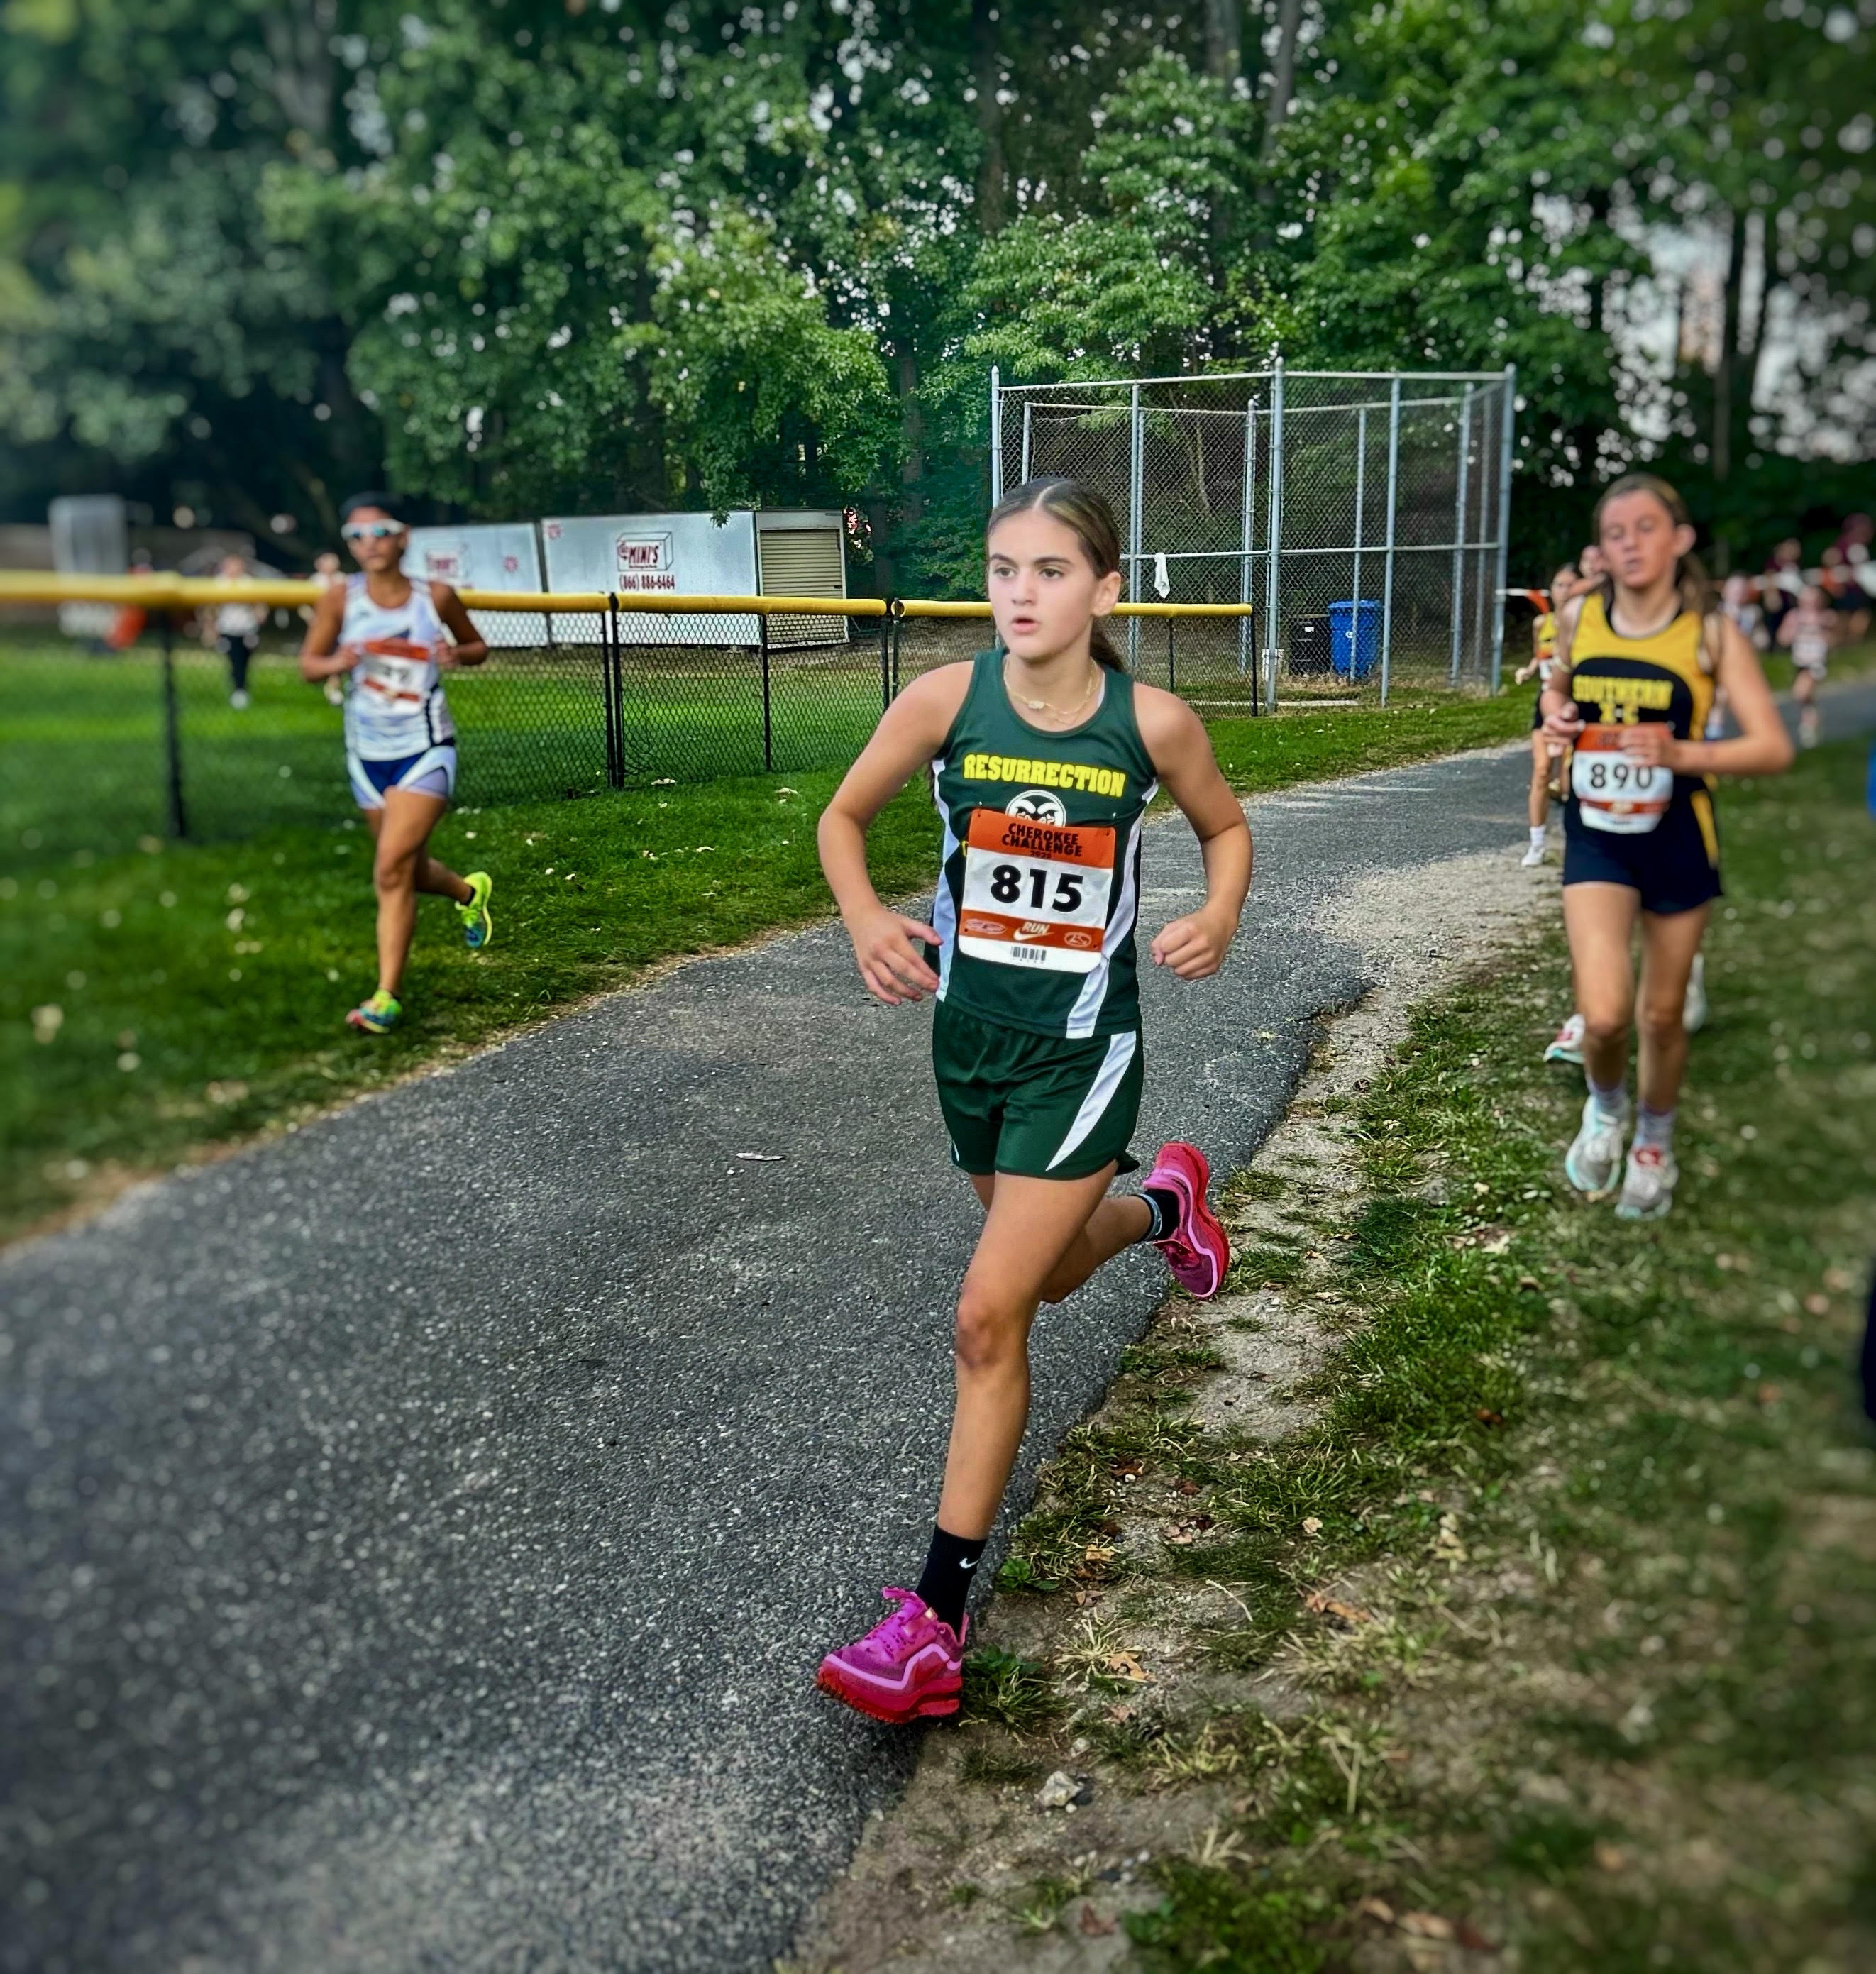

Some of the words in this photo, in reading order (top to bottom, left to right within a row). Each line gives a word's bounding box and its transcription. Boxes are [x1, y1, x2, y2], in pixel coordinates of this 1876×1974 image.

[629, 546, 659, 563] MINI'S
[619, 573, 639, 591] (866)
[641, 574, 675, 590] 886-6464
[964, 754, 1126, 798] RESURRECTION
[1591, 763, 1652, 789] 890
[1008, 823, 1078, 844] CHEROKEE
[1001, 834, 1082, 856] CHALLENGE
[991, 864, 1083, 912] 815
[1022, 921, 1050, 934] RUN
